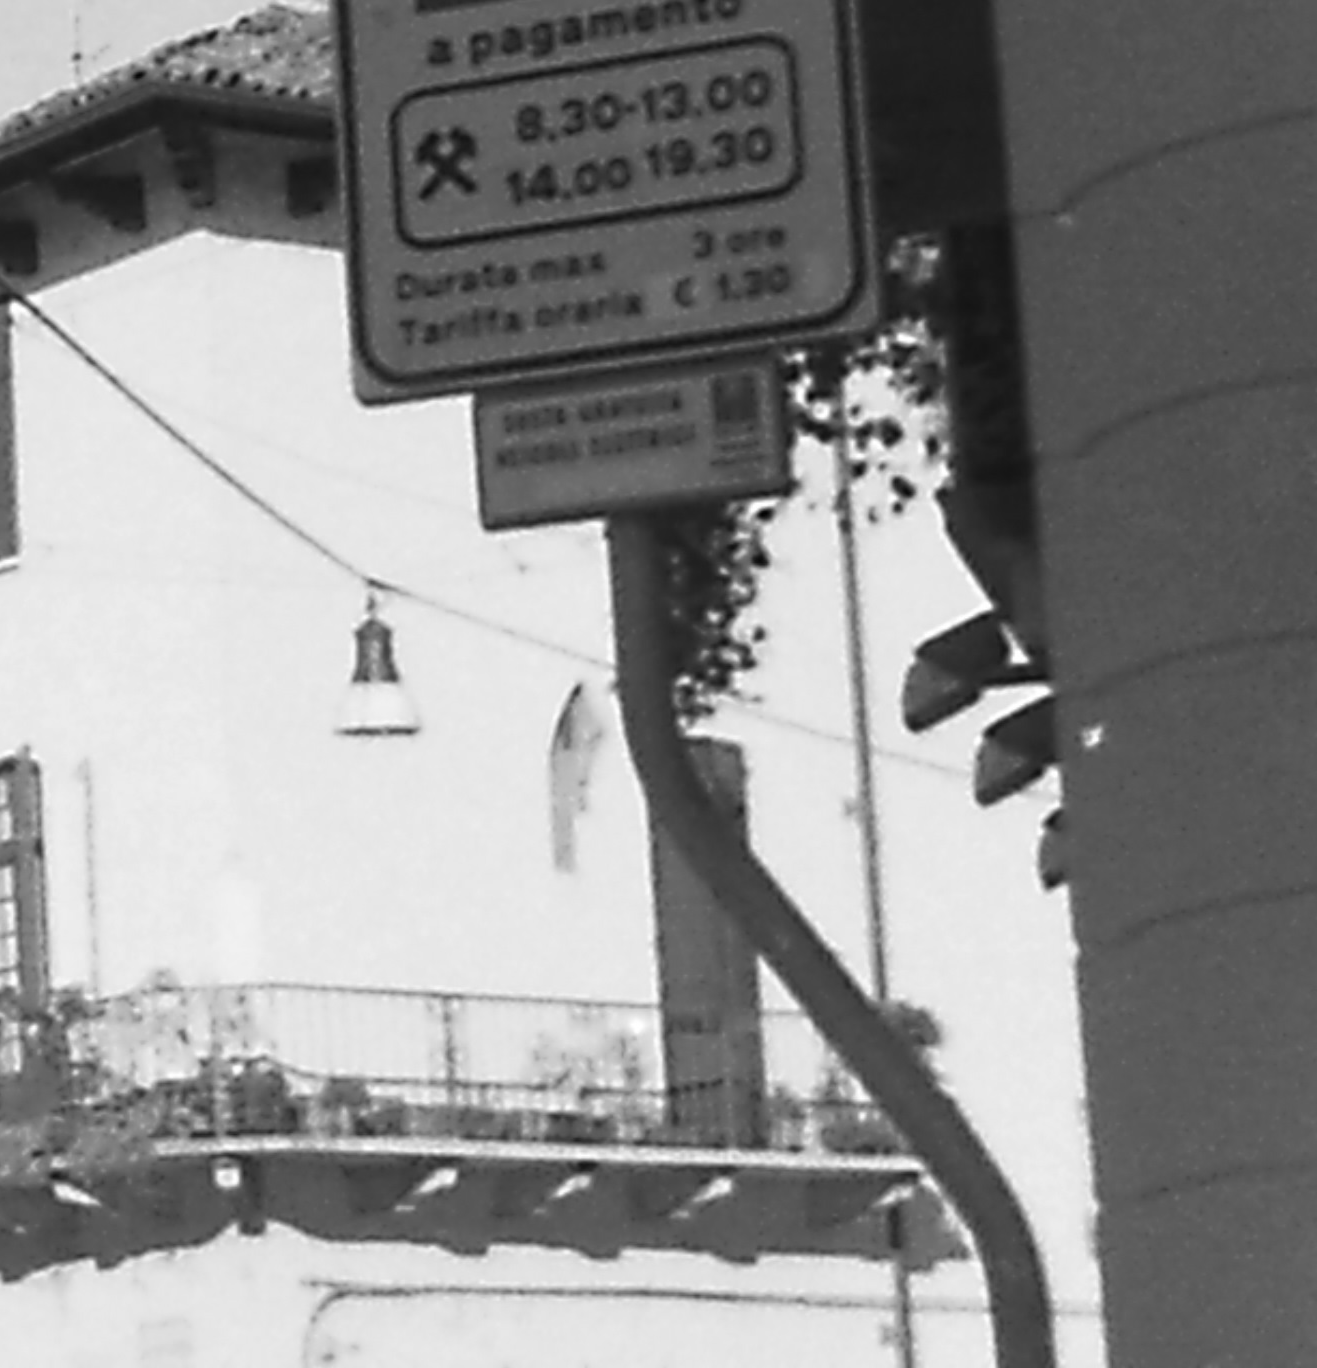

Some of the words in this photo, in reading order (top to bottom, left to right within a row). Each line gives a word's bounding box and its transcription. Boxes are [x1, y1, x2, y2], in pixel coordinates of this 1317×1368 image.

[427, 38, 454, 67] a
[516, 70, 773, 143] 8.30-13.00
[506, 158, 633, 206] 14.00
[646, 126, 775, 178] 19.30
